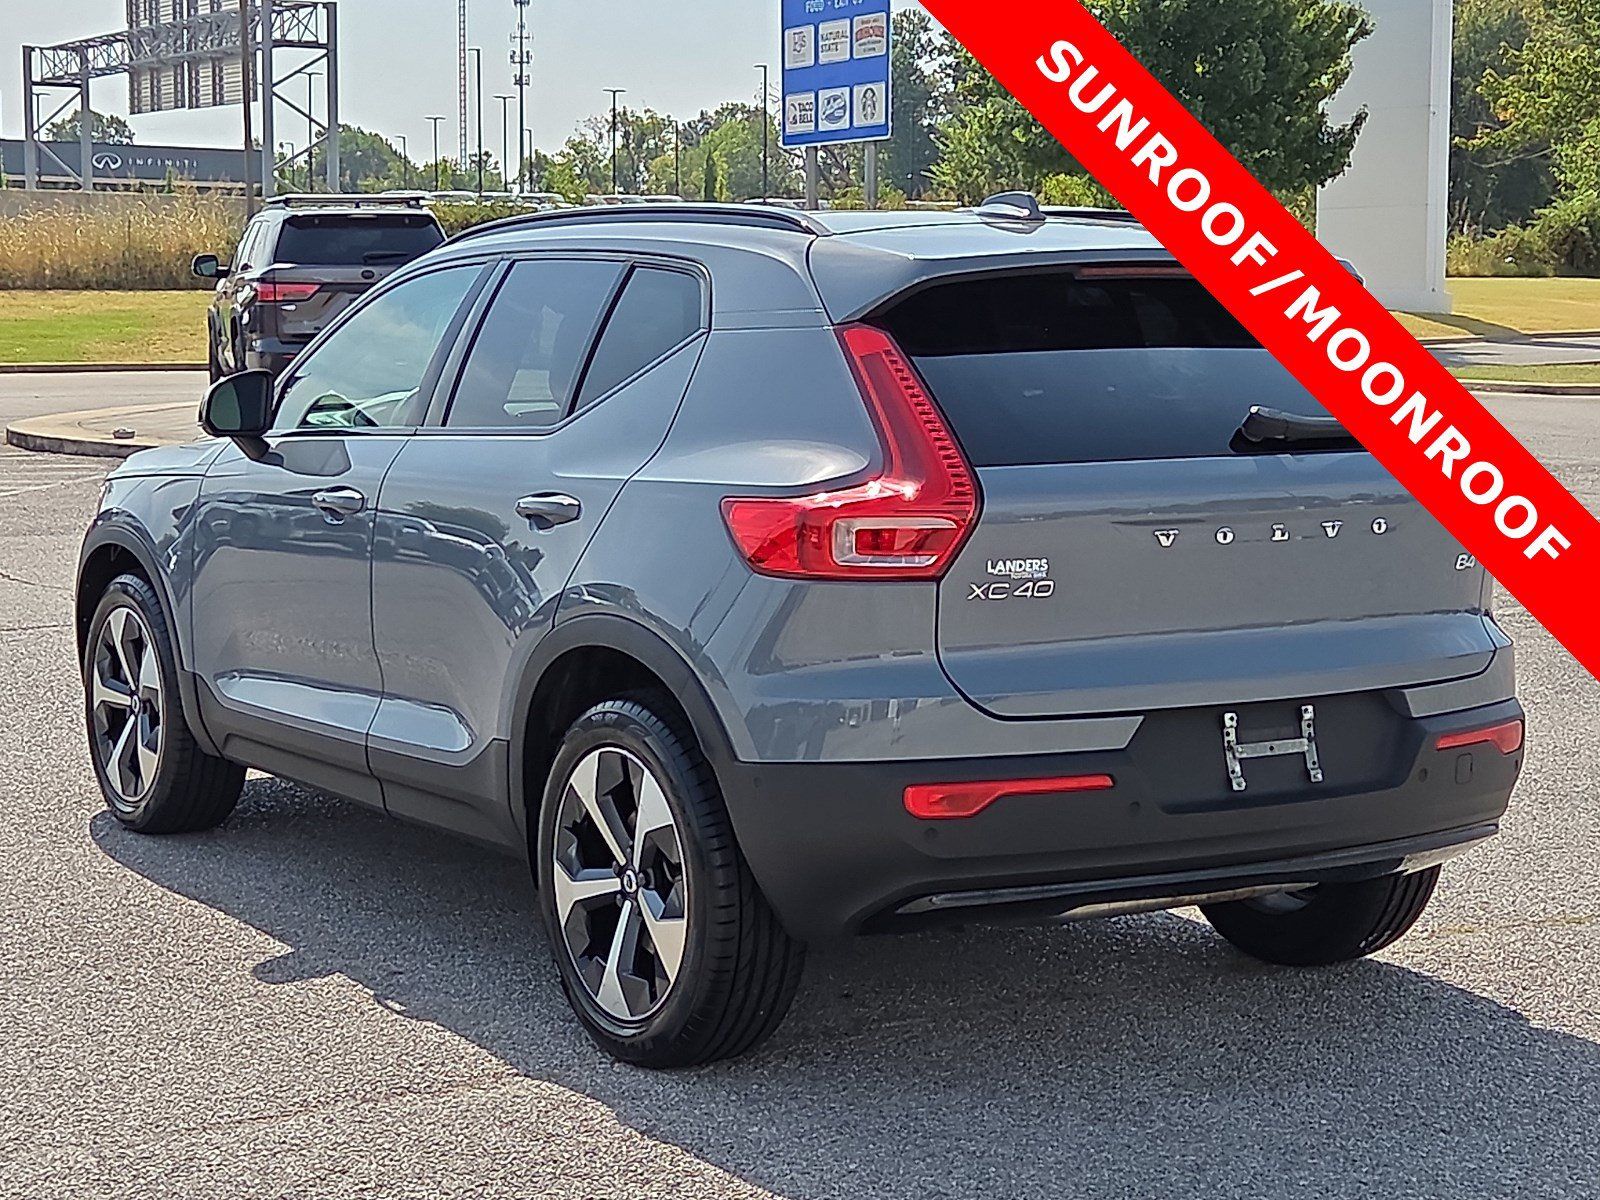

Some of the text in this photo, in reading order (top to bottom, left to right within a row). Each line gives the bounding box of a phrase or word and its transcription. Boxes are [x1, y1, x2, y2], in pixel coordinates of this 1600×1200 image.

[798, 101, 813, 112] TACO
[799, 113, 813, 125] BELL
[128, 157, 197, 168] INFINITI
[1153, 517, 1389, 548] VOLVO
[987, 558, 1049, 574] LANDERS
